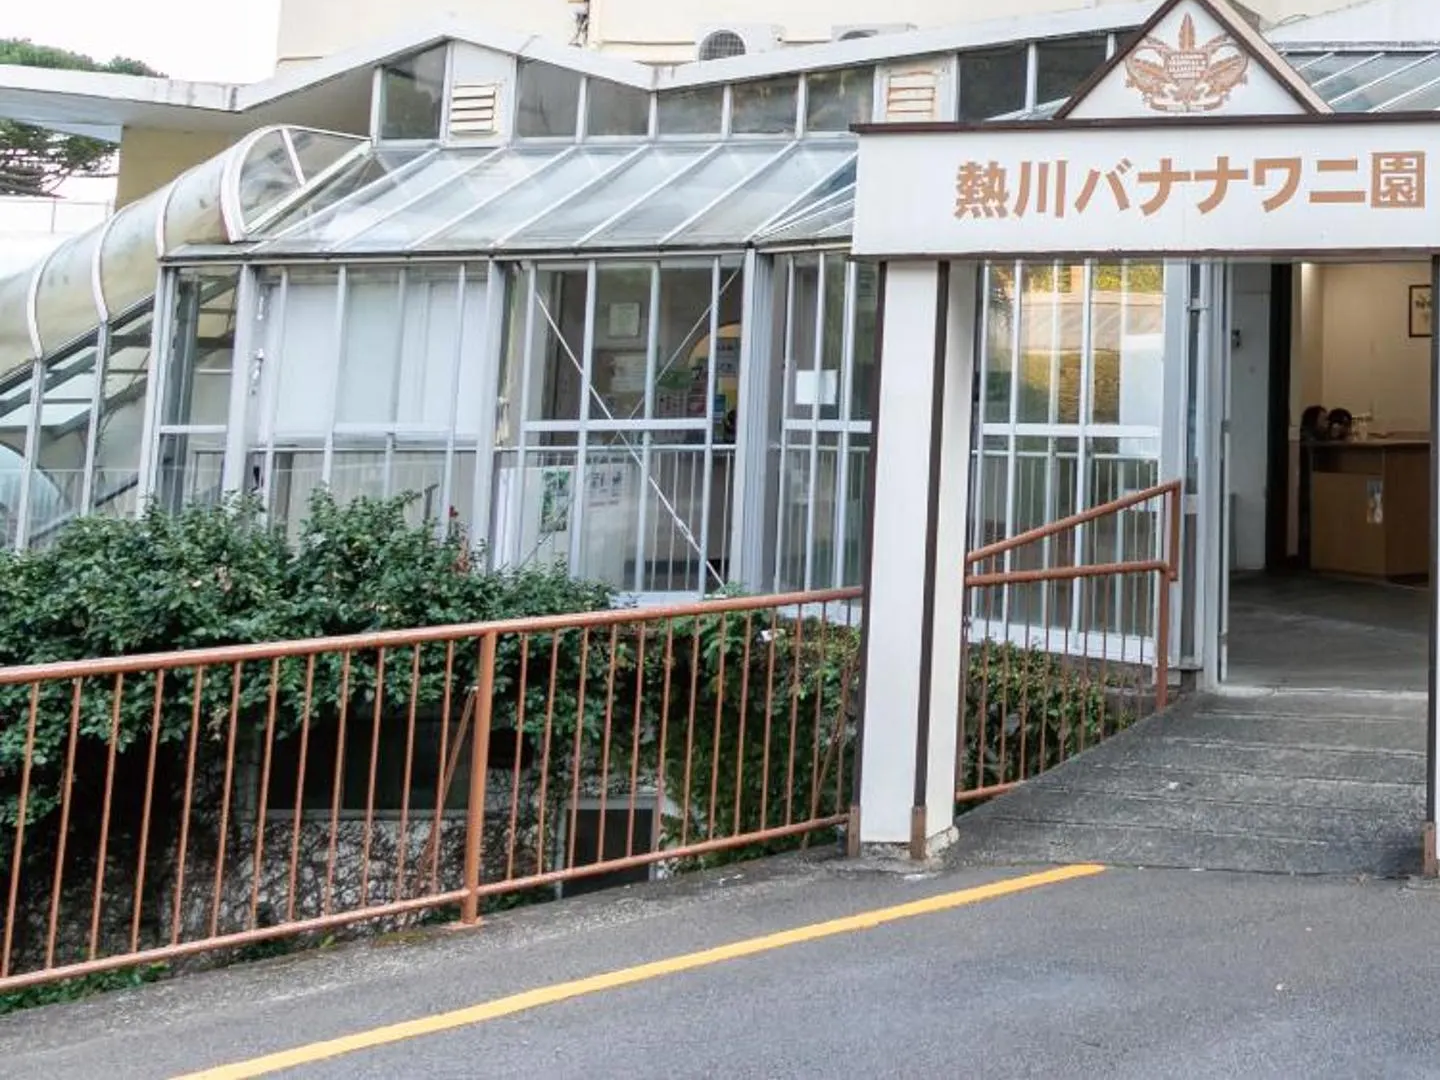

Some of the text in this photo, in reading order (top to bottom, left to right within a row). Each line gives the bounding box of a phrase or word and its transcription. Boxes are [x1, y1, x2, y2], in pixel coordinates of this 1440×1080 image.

[953, 151, 1426, 218] 熱川バナナワニ園
